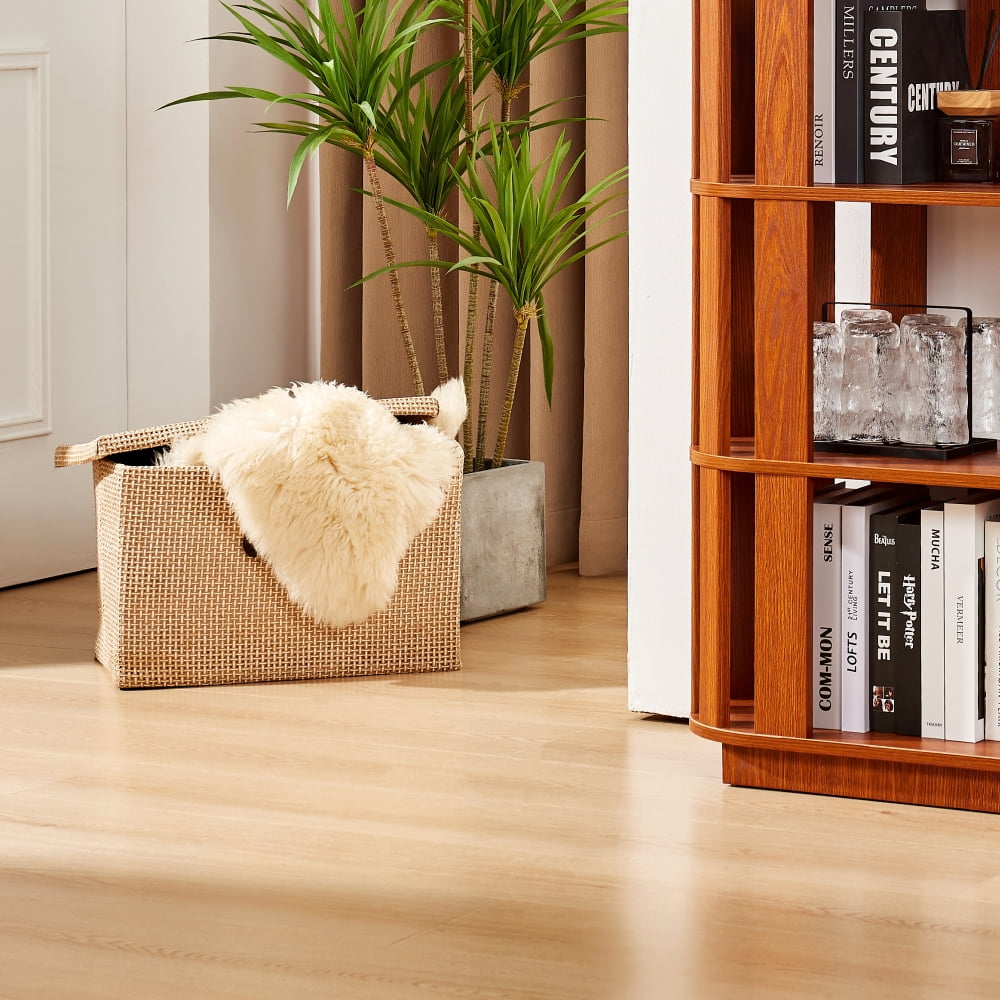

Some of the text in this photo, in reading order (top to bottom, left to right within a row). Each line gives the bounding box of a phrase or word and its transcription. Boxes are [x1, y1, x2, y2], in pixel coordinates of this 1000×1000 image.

[842, 5, 855, 80] MILLERS
[869, 28, 898, 166] CENTURY
[814, 113, 824, 167] RENOIR
[823, 523, 833, 562] SENSE
[931, 528, 941, 571] MUCHA
[877, 571, 891, 661] LET IT BE
[899, 574, 917, 649] Harry Potter
[956, 595, 964, 644] VERMEER
[818, 626, 833, 712] COM-MON
[846, 631, 857, 673] LOFTS
